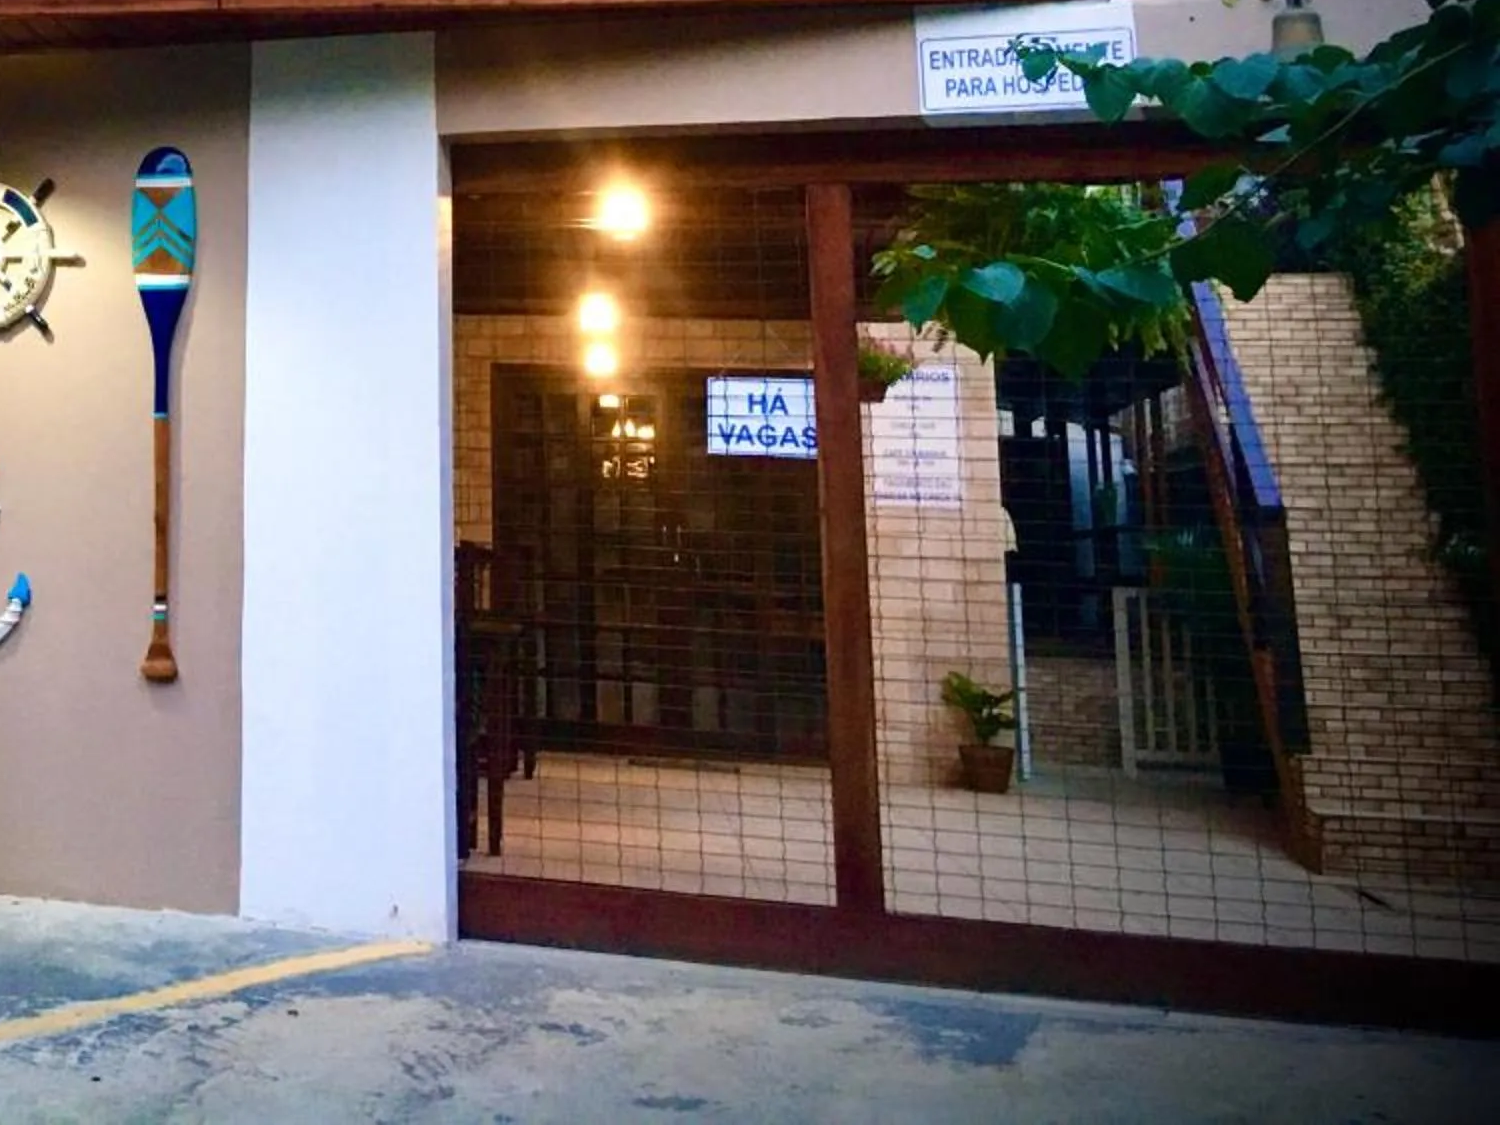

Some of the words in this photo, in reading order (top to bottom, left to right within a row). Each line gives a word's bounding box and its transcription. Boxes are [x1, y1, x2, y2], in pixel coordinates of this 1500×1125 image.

[929, 46, 1021, 70] ENTRADA
[945, 77, 997, 98] PARA
[1003, 73, 1089, 95] HOSPED
[747, 387, 789, 416] HÁ
[717, 422, 818, 450] VAGAS
